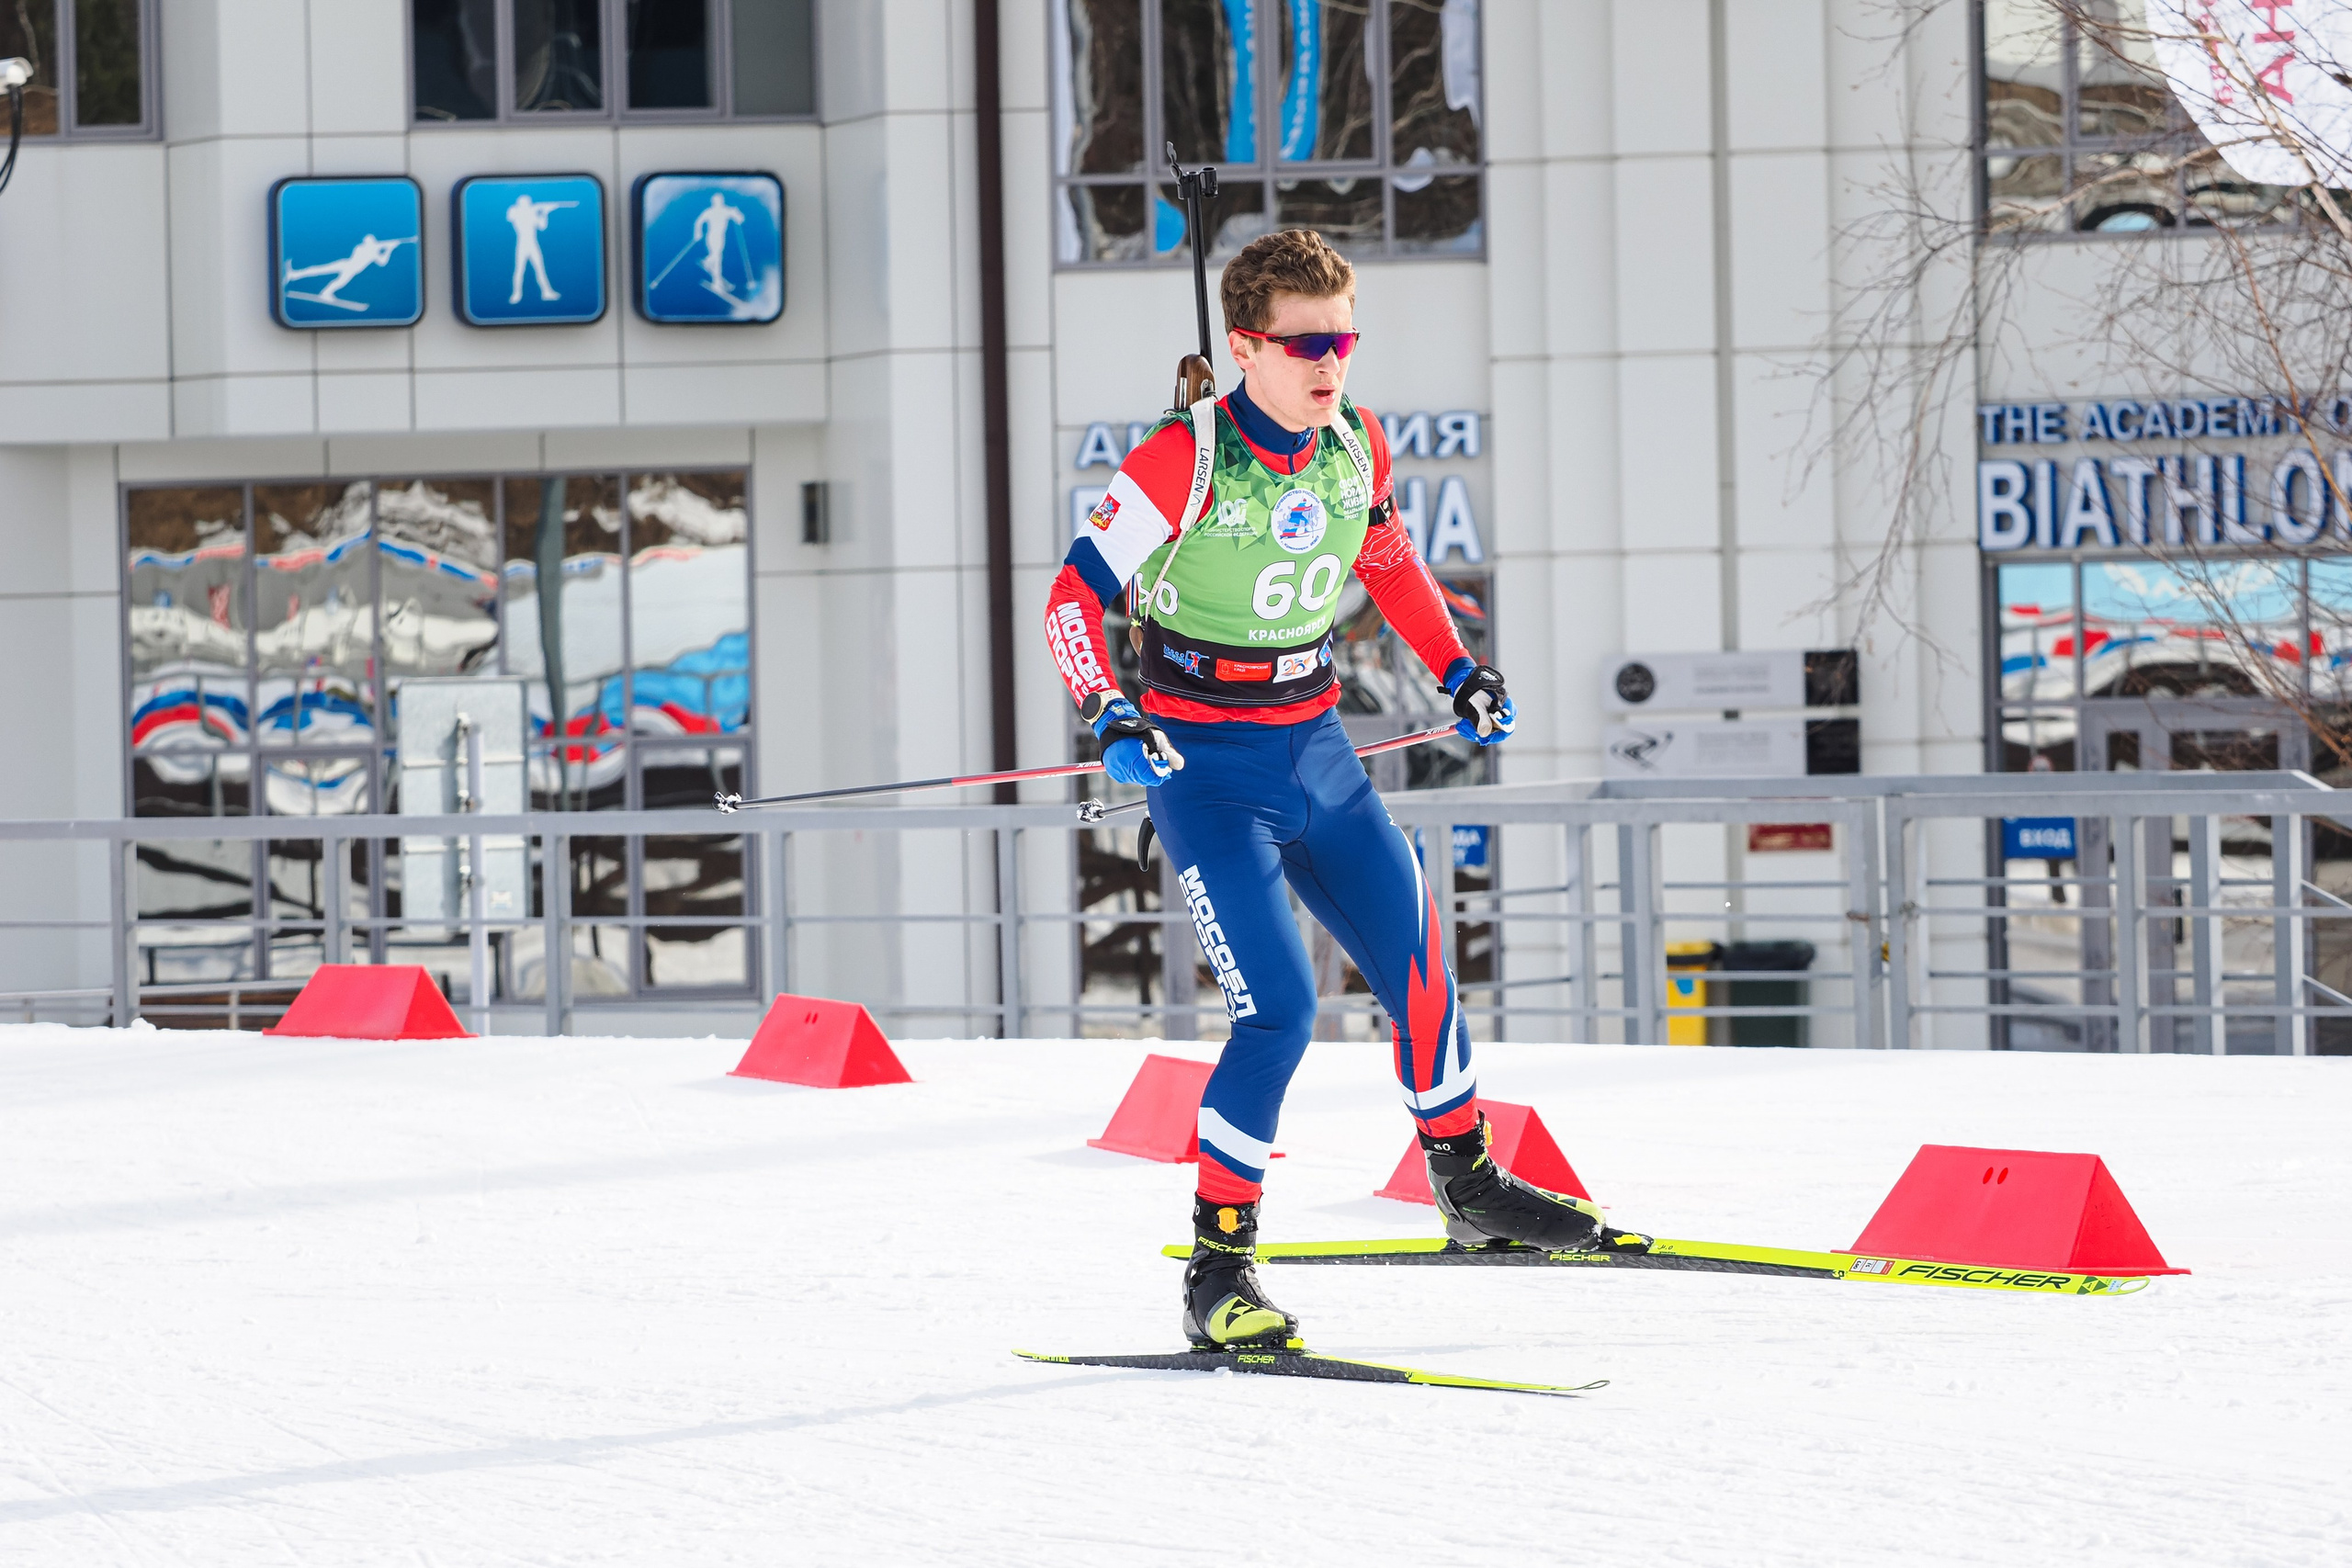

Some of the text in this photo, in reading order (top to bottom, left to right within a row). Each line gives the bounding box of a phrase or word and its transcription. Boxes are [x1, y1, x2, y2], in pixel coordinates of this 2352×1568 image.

[1978, 403, 2068, 445] THE
[1342, 431, 1369, 473] LARSEN
[1194, 446, 1210, 494] LARSEN
[1275, 490, 1320, 512] ПЕРВЕНСТВО РОССИИ
[1251, 553, 1341, 620] 60
[2019, 828, 2072, 850] ВХОД
[1183, 864, 1258, 1019] МОСОБЛ
[1433, 1143, 1451, 1152] 60
[1197, 1235, 1255, 1255] FISCHER
[1549, 1253, 1611, 1262] FISCHER
[1897, 1265, 2071, 1290] FISCHER
[1237, 1354, 1275, 1364] FISCHER
